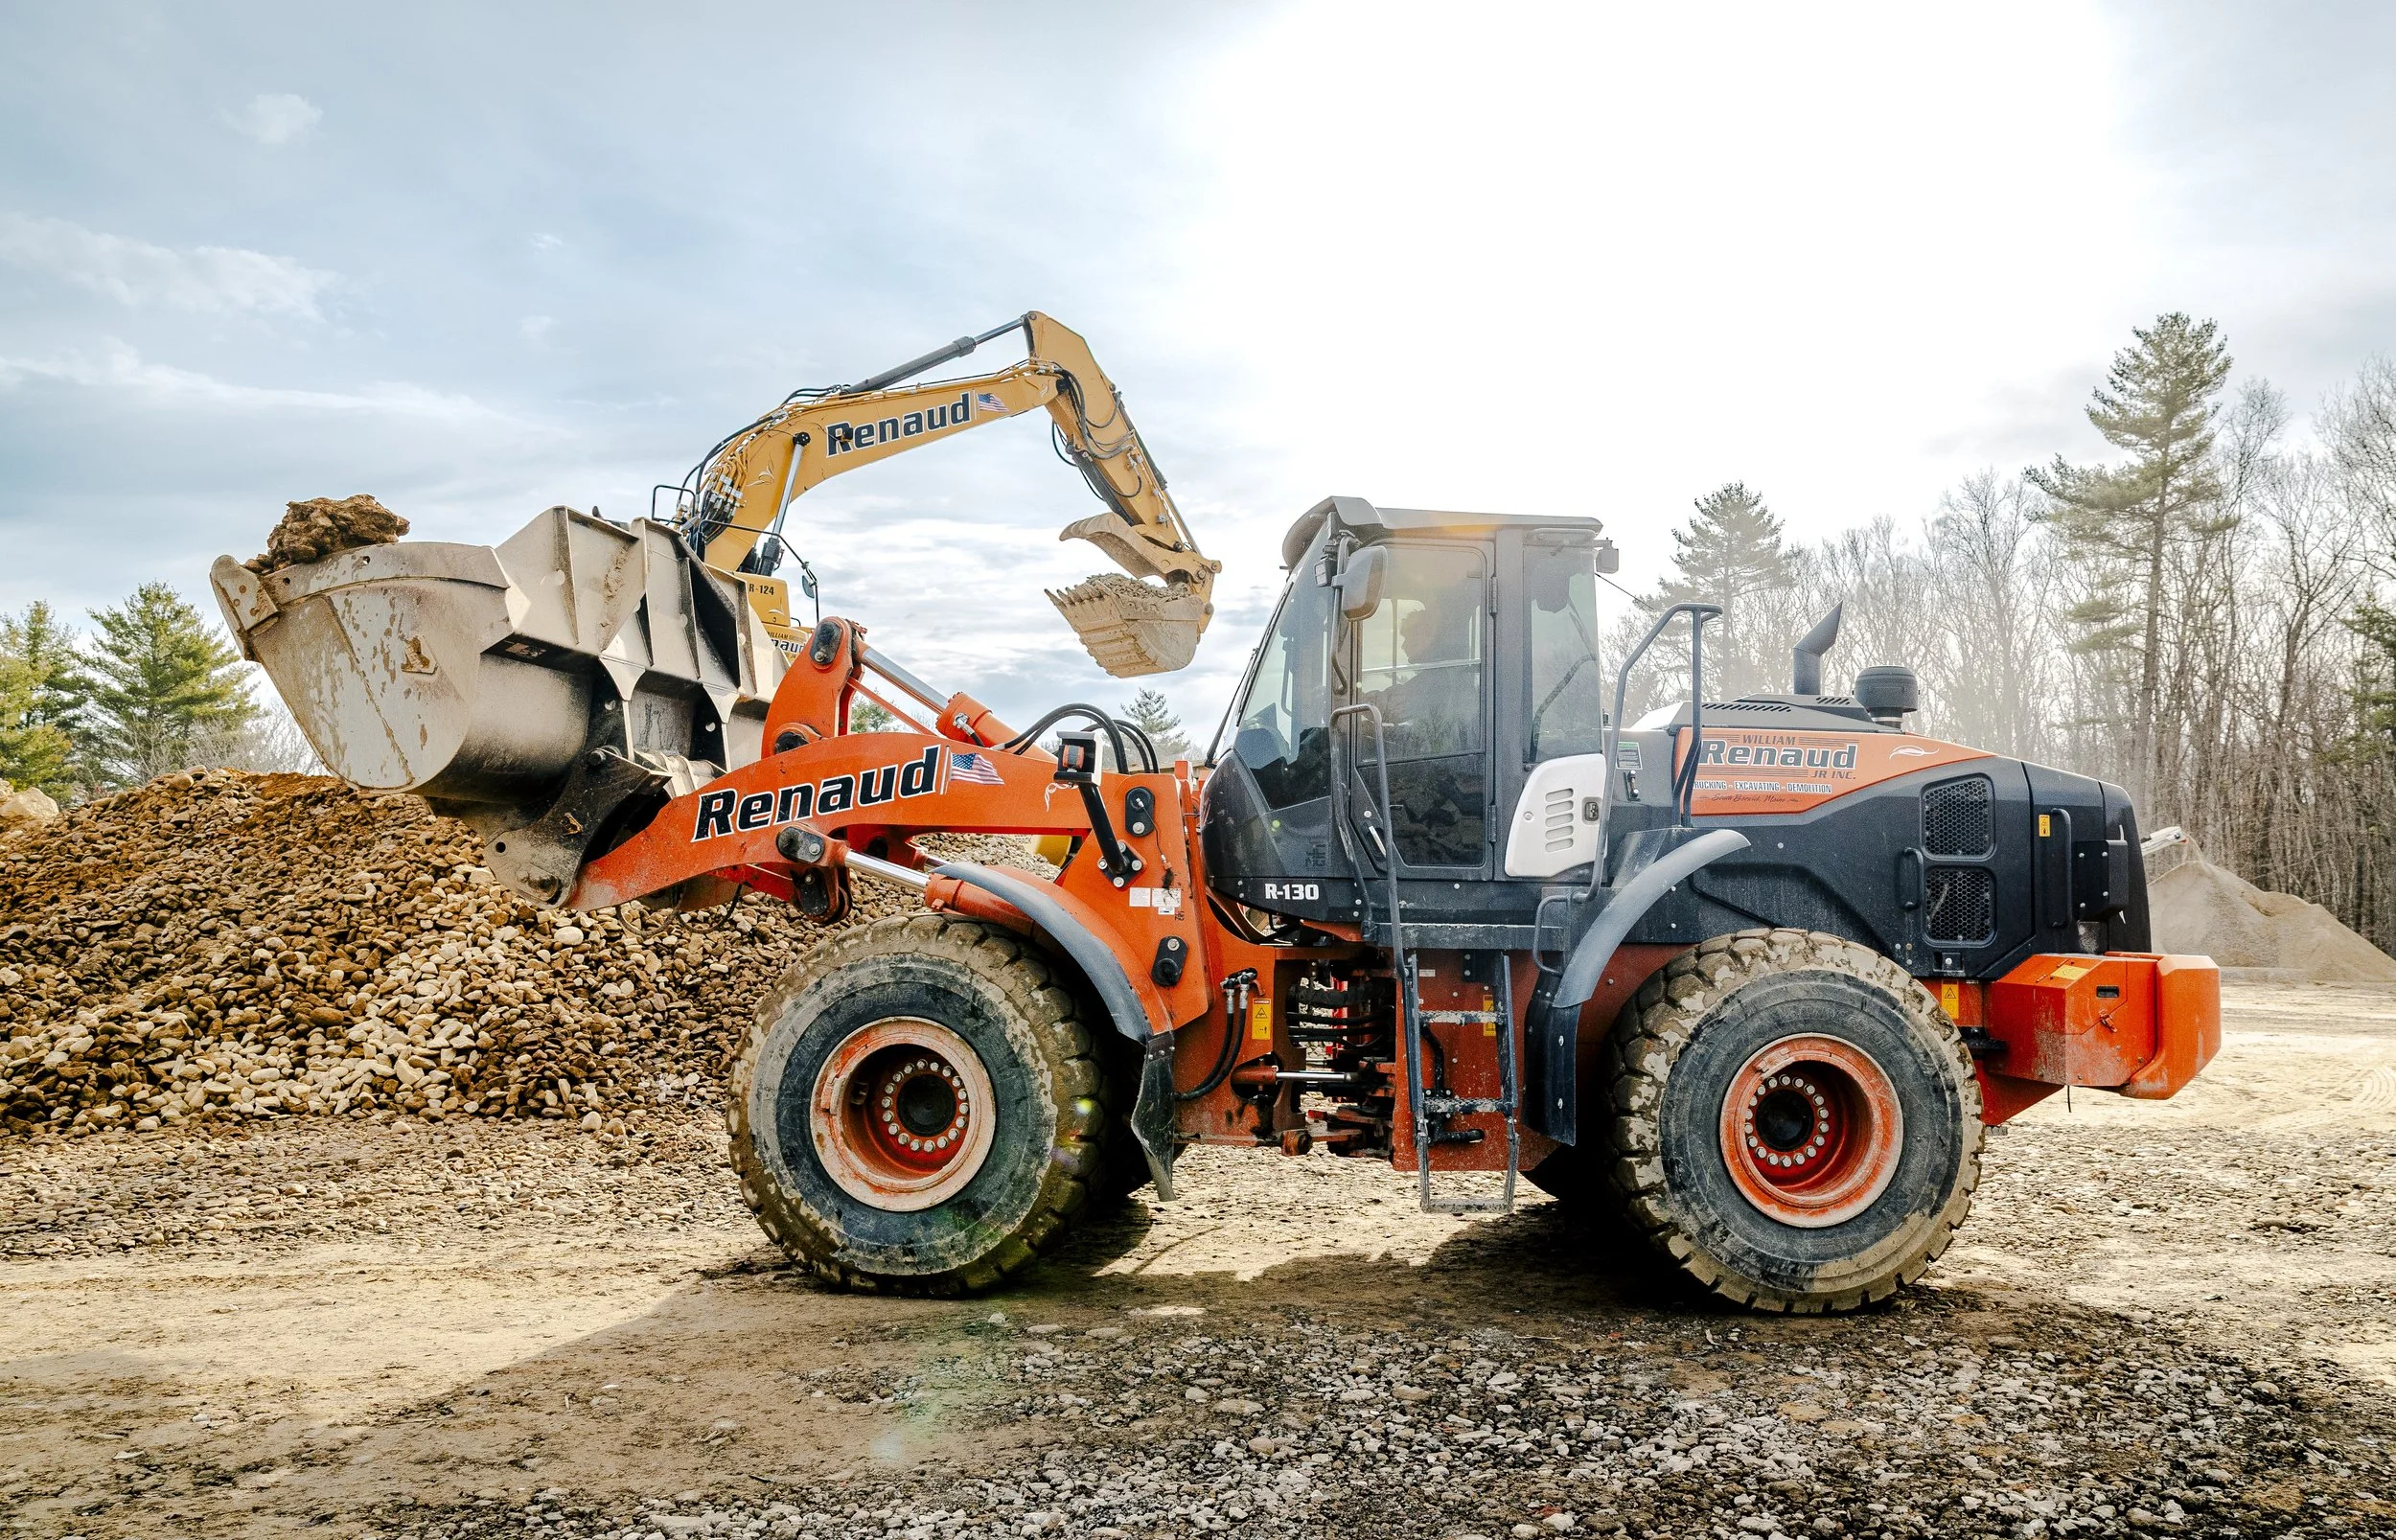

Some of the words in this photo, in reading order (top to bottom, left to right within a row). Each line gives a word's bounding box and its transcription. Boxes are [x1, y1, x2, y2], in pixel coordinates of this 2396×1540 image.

[825, 390, 971, 458] Renaud
[749, 583, 774, 596] R-124
[1742, 734, 1796, 746] WILLIAM
[1698, 739, 1858, 770] Renaud
[1810, 770, 1828, 778] JR
[1832, 770, 1856, 780] INC.
[690, 744, 942, 843] Renaud
[1693, 780, 1727, 791] RUCKING
[1734, 781, 1780, 792] EXCAVATING
[1787, 783, 1832, 793] DEMOLITION
[1264, 883, 1320, 901] R-130
